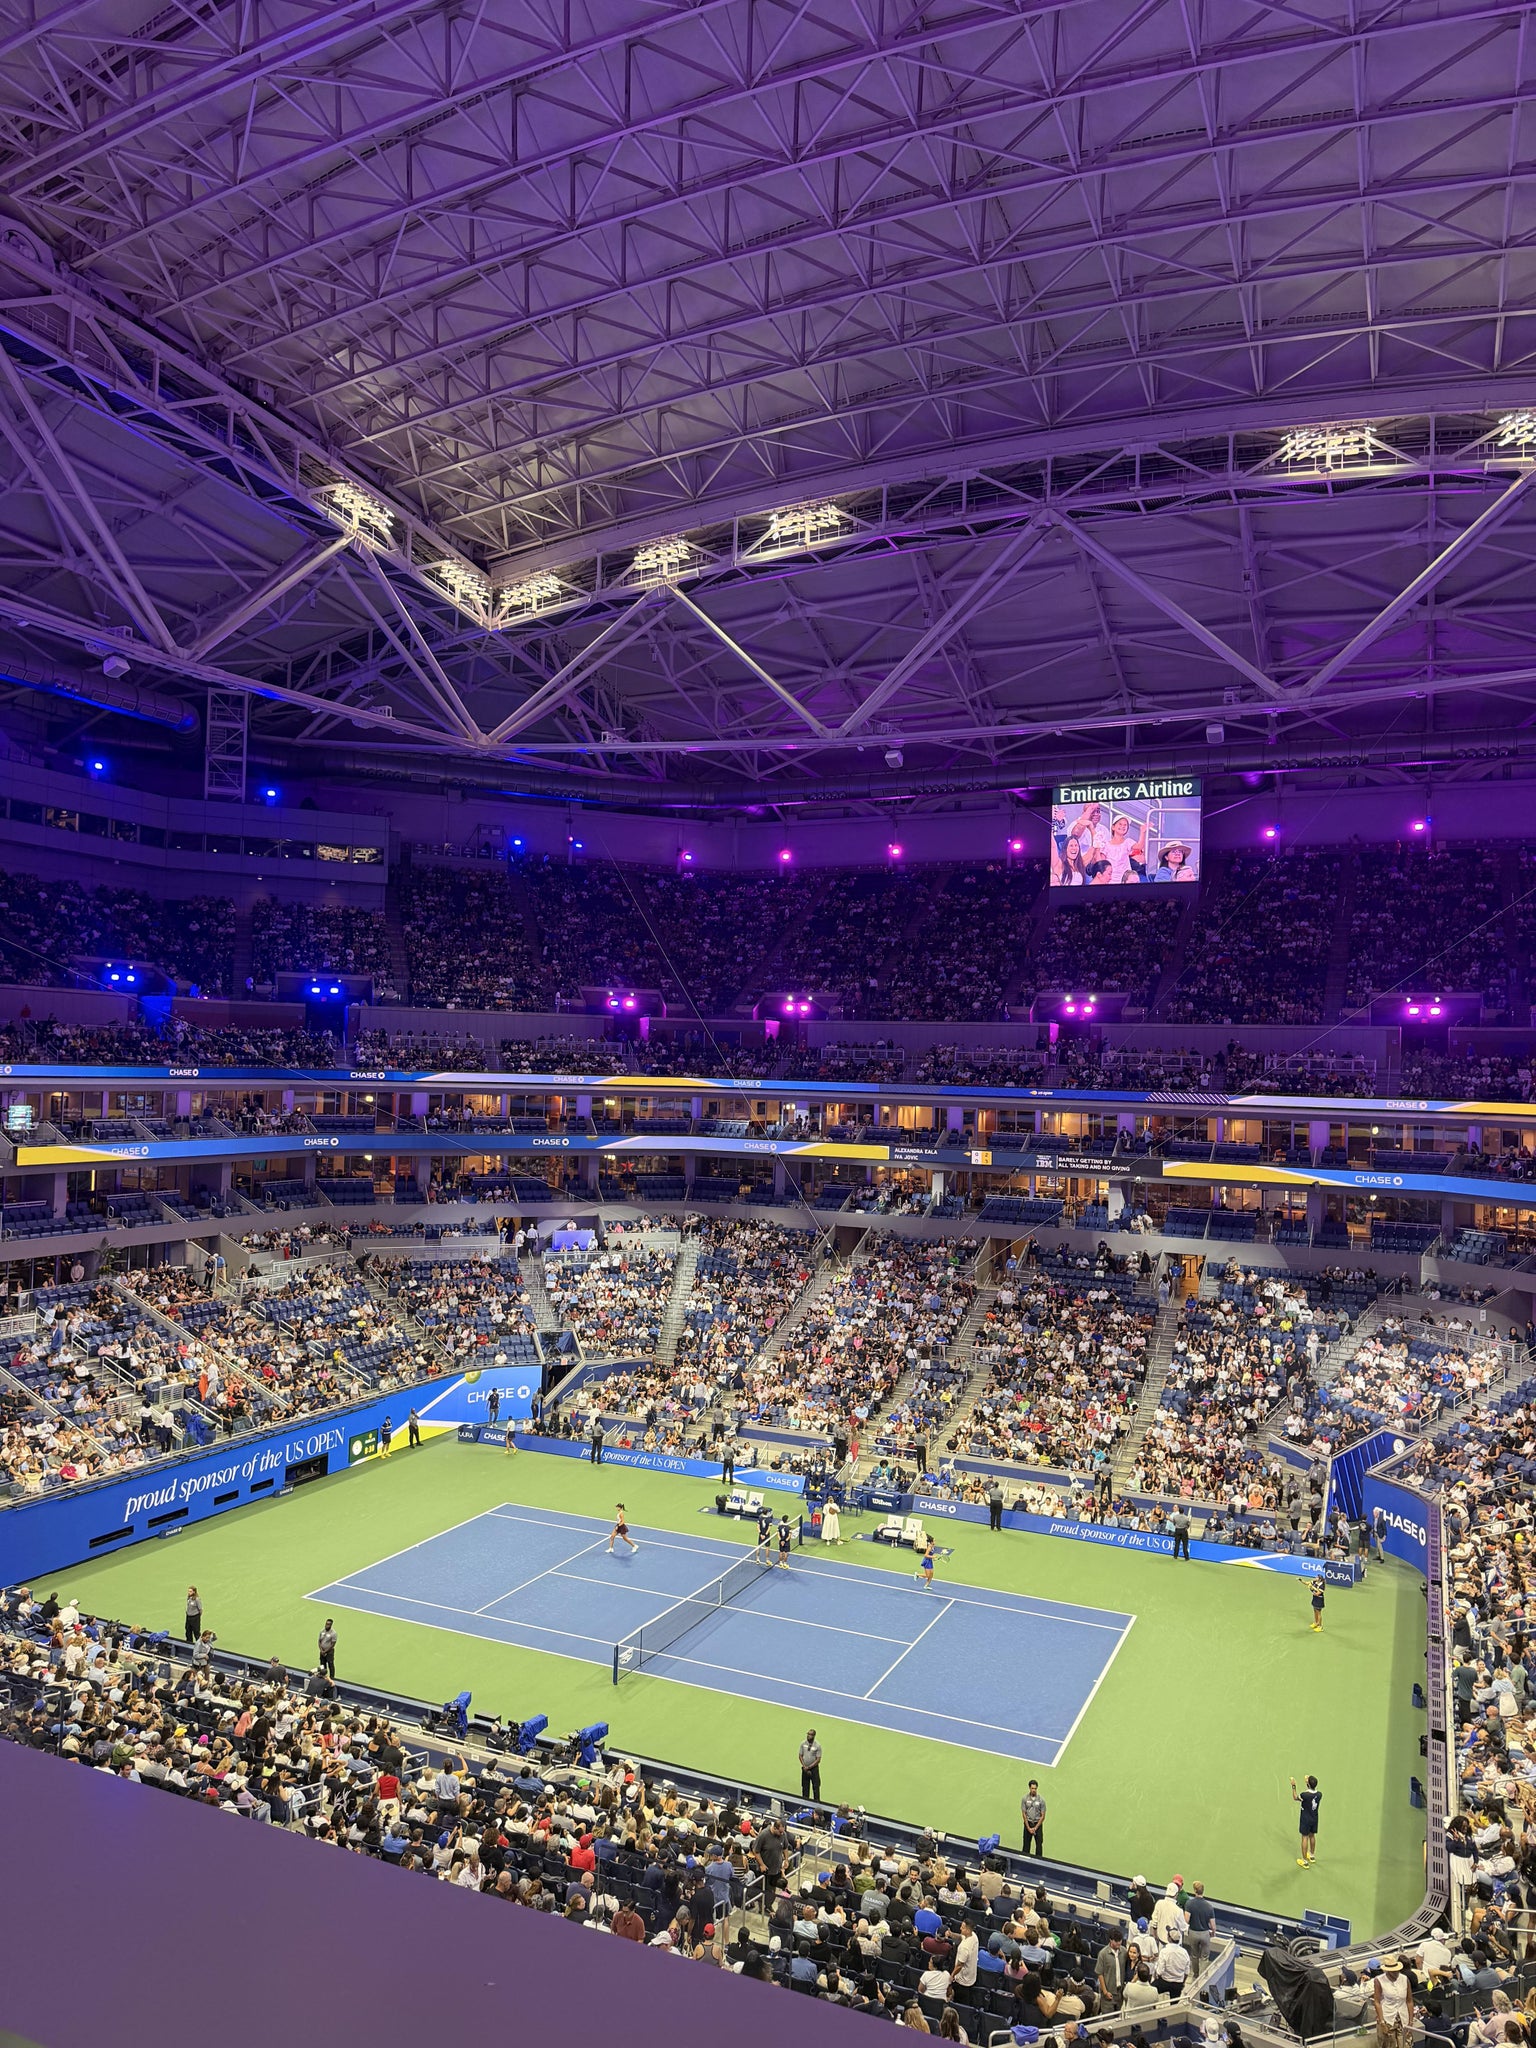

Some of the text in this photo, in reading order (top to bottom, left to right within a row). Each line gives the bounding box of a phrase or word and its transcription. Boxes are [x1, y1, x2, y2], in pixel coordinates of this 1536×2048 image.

[1060, 781, 1193, 804] Emirates Airline
[1386, 1101, 1417, 1109] CHASE
[304, 1138, 329, 1146] CHASE
[533, 1138, 561, 1146] CHASE
[744, 1142, 769, 1150] CHASE
[112, 1147, 140, 1157] CHASE
[1035, 1160, 1053, 1168] IBM
[1355, 1175, 1391, 1184] CHASE
[484, 1433, 506, 1441] CHASE
[603, 1451, 631, 1462] sponsor
[631, 1454, 641, 1465] of
[640, 1455, 652, 1465] the
[653, 1457, 664, 1467] US
[664, 1458, 687, 1470] OPEN
[123, 1427, 345, 1522] proud sponsor of the US OPEN
[766, 1476, 792, 1486] CHASE
[872, 1497, 893, 1507] Wilson
[920, 1501, 948, 1511] CHASE
[1050, 1523, 1078, 1535] proud
[1080, 1528, 1116, 1541] sponsor
[1117, 1533, 1129, 1545] of
[1129, 1534, 1145, 1546] the
[1146, 1537, 1160, 1549] US
